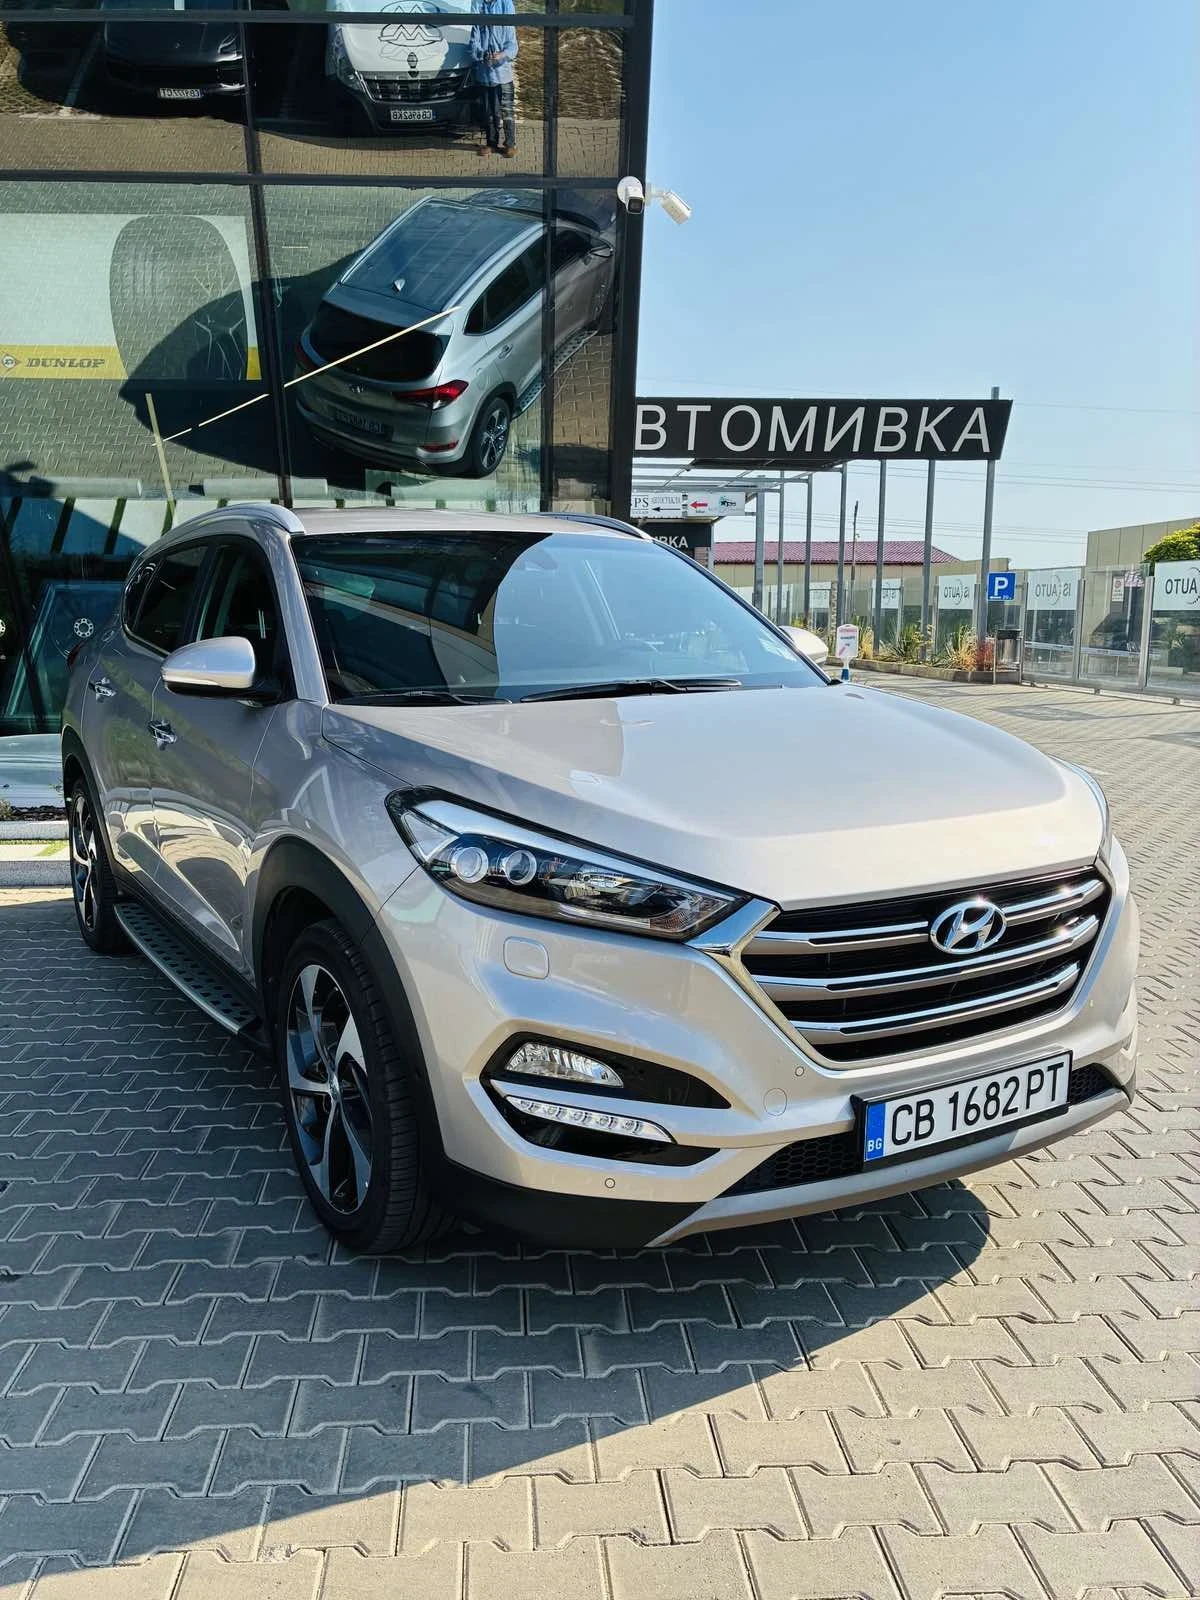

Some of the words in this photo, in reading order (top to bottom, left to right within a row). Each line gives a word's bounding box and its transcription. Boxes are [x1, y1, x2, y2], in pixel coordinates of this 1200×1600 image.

[25, 358, 105, 368] DUNLOP
[631, 497, 649, 508] PS
[994, 576, 1009, 597] P
[891, 1098, 935, 1146] CB
[867, 1138, 883, 1152] BG
